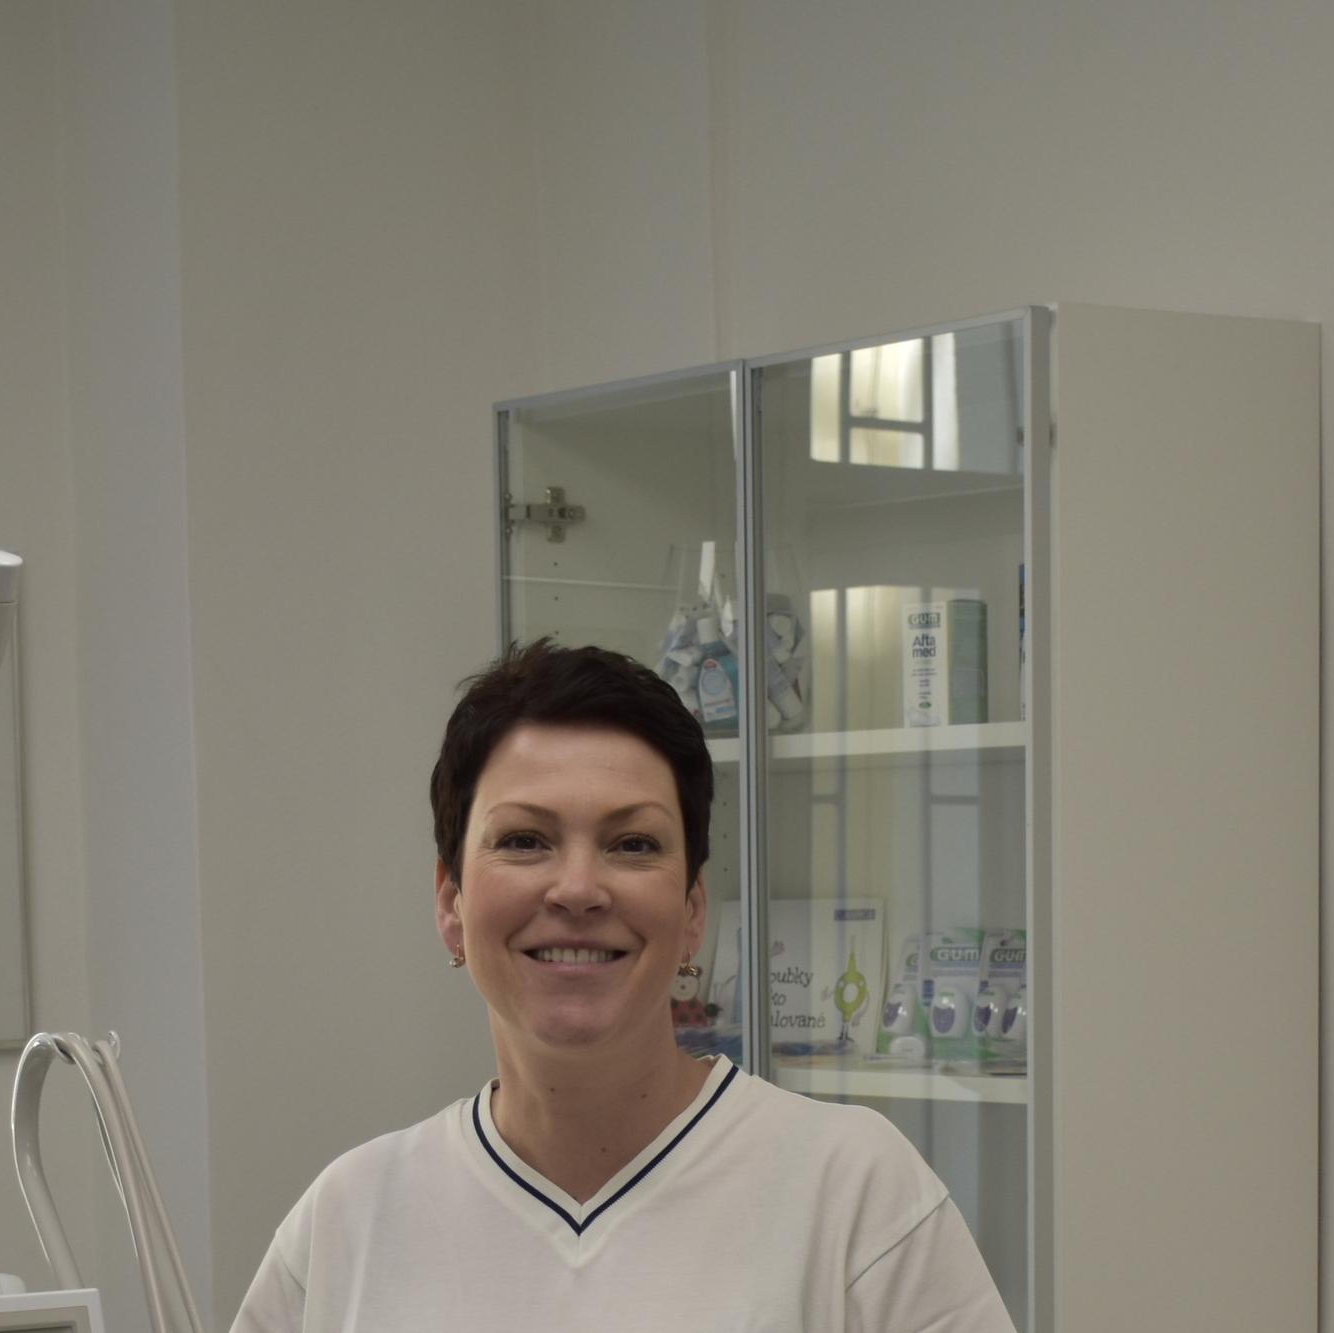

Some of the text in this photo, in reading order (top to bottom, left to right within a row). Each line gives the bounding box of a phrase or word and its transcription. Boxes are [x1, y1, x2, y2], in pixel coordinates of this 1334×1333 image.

[912, 612, 941, 625] GUM
[912, 633, 936, 647] Afta
[912, 647, 937, 658] med
[937, 948, 980, 961] GUM
[770, 966, 814, 988] oubky
